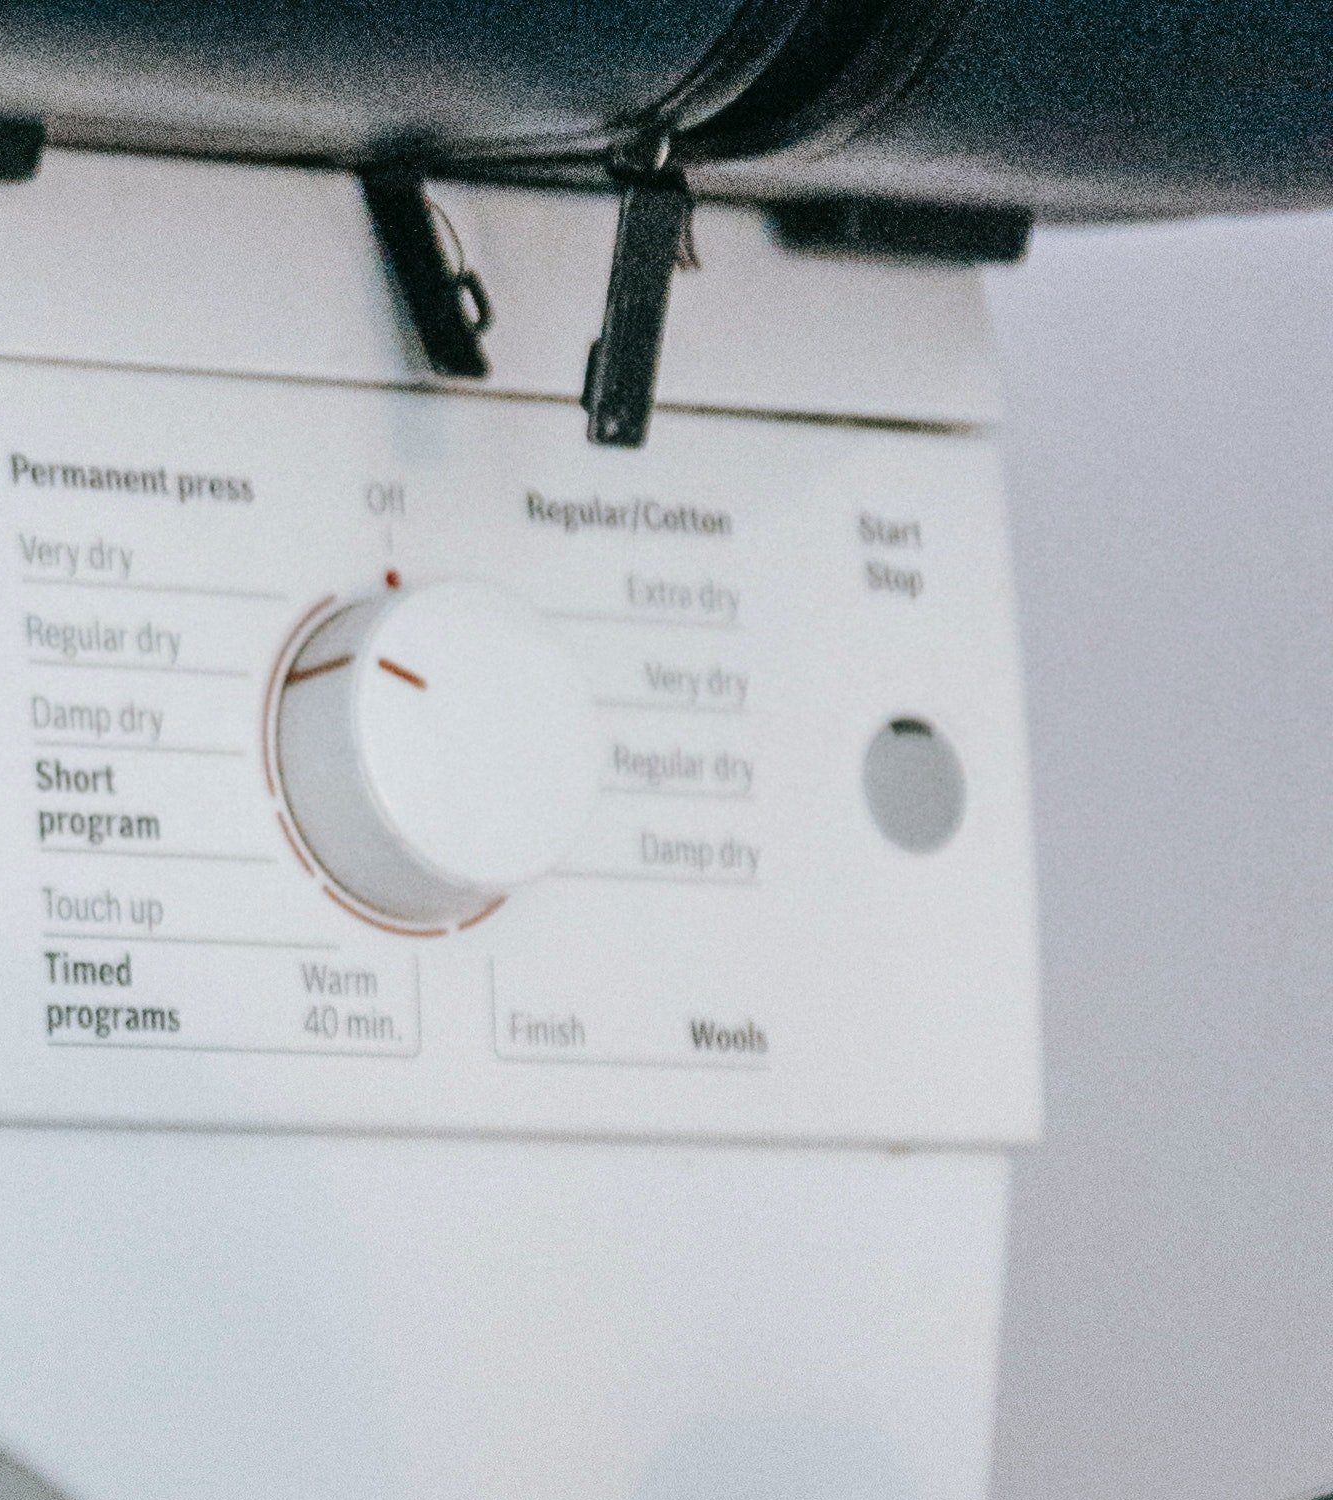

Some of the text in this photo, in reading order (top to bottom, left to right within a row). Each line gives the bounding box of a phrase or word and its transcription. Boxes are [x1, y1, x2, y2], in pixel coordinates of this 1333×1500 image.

[9, 451, 255, 504] Permanent press
[366, 481, 406, 517] Off
[525, 488, 734, 537] Regular/Cotton
[858, 511, 922, 549] Start
[18, 533, 134, 580] Very dry
[626, 572, 741, 621] Extra dry
[865, 560, 924, 600] Stop
[25, 612, 181, 665] Regular dry
[643, 660, 750, 706] Very dry
[30, 694, 165, 744] Damp dry
[33, 759, 116, 794] Short
[612, 743, 754, 795] Regular dry
[37, 809, 161, 843] program
[640, 831, 759, 877] Damp dry
[41, 886, 164, 929] Touch up
[44, 951, 133, 988] Timed
[300, 962, 379, 997] Warm
[46, 1003, 181, 1038] programs
[303, 1004, 403, 1042] 40 min.
[511, 1011, 586, 1049] Finish
[690, 1017, 768, 1054] Wools
